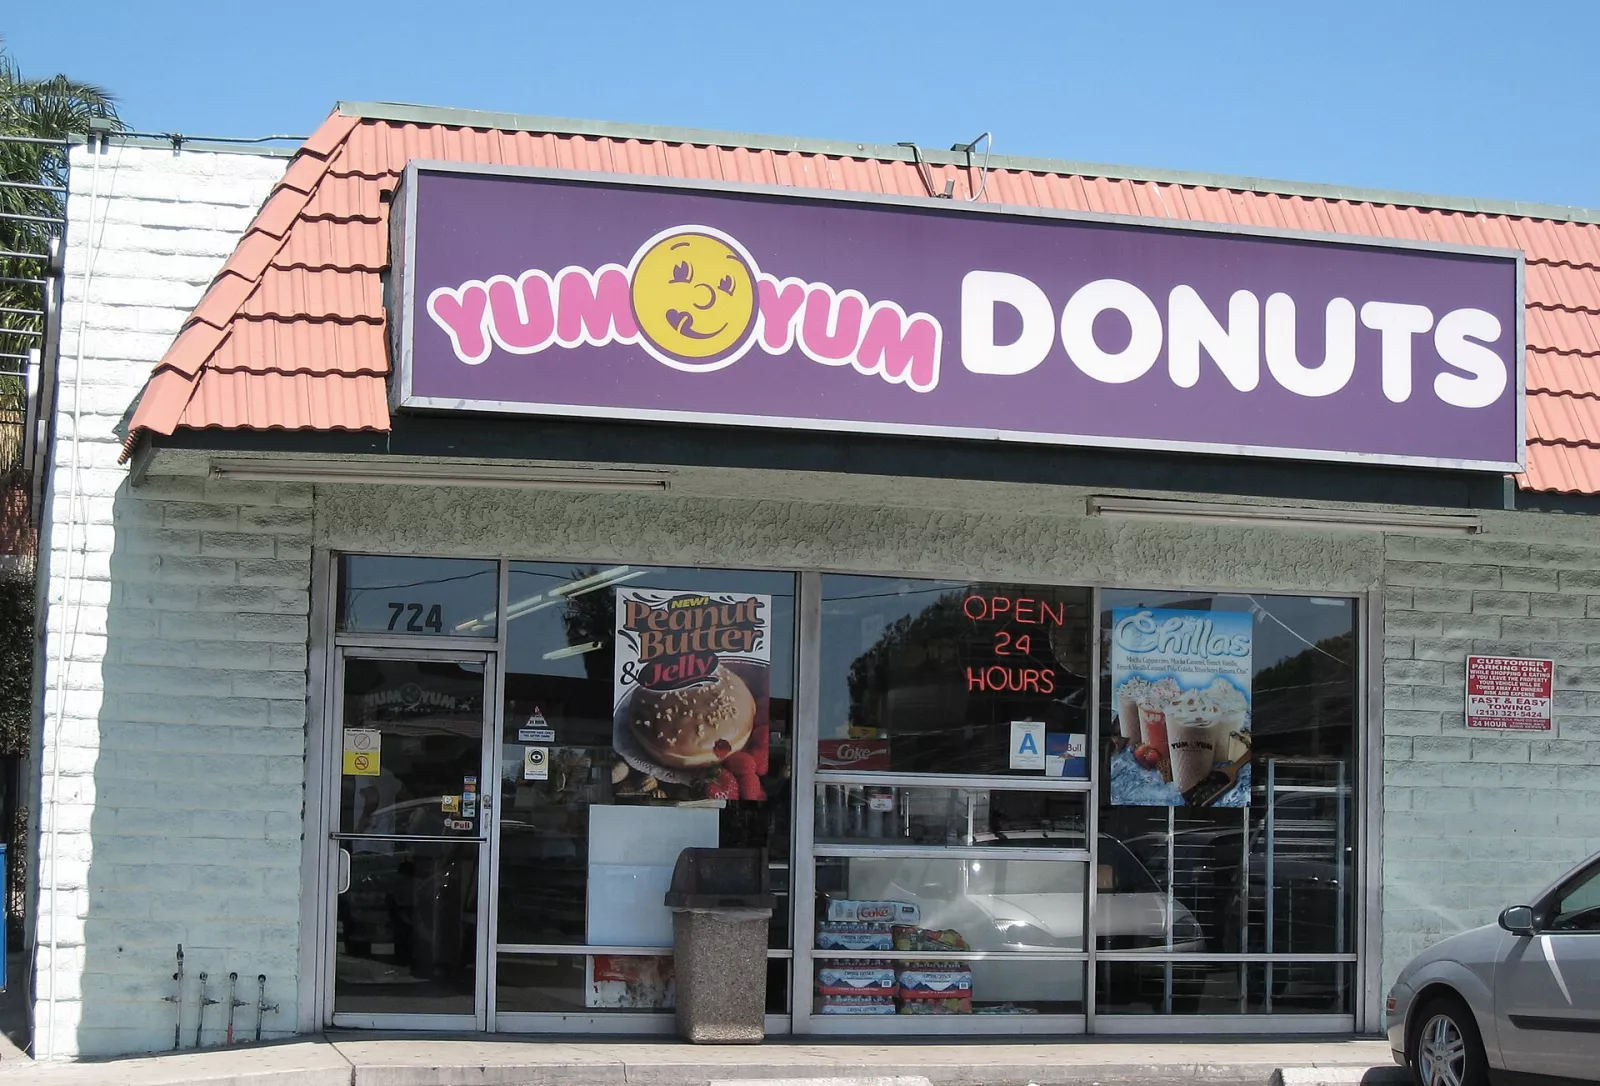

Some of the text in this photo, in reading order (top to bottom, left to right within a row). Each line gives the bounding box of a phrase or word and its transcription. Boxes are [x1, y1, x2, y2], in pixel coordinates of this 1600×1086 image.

[429, 265, 1507, 408] YUM YUM DONUTS
[670, 596, 710, 608] NEW!
[964, 595, 1064, 626] OPEN
[388, 602, 442, 632] 724
[624, 597, 764, 631] Peanut
[639, 626, 763, 662] Butter
[994, 631, 1031, 655] 24
[1115, 611, 1250, 658] Chillas
[620, 652, 715, 688] & Jelly
[1477, 659, 1545, 667] CUSTOMER
[966, 665, 1056, 694] HOURS
[421, 690, 456, 709] YUM
[1516, 698, 1547, 707] EASY
[837, 744, 871, 760] Coke
[1018, 732, 1038, 754] A
[1067, 744, 1082, 752] Bull
[1171, 741, 1189, 749] YUM
[1196, 741, 1213, 751] YUM
[861, 907, 890, 918] Coke
